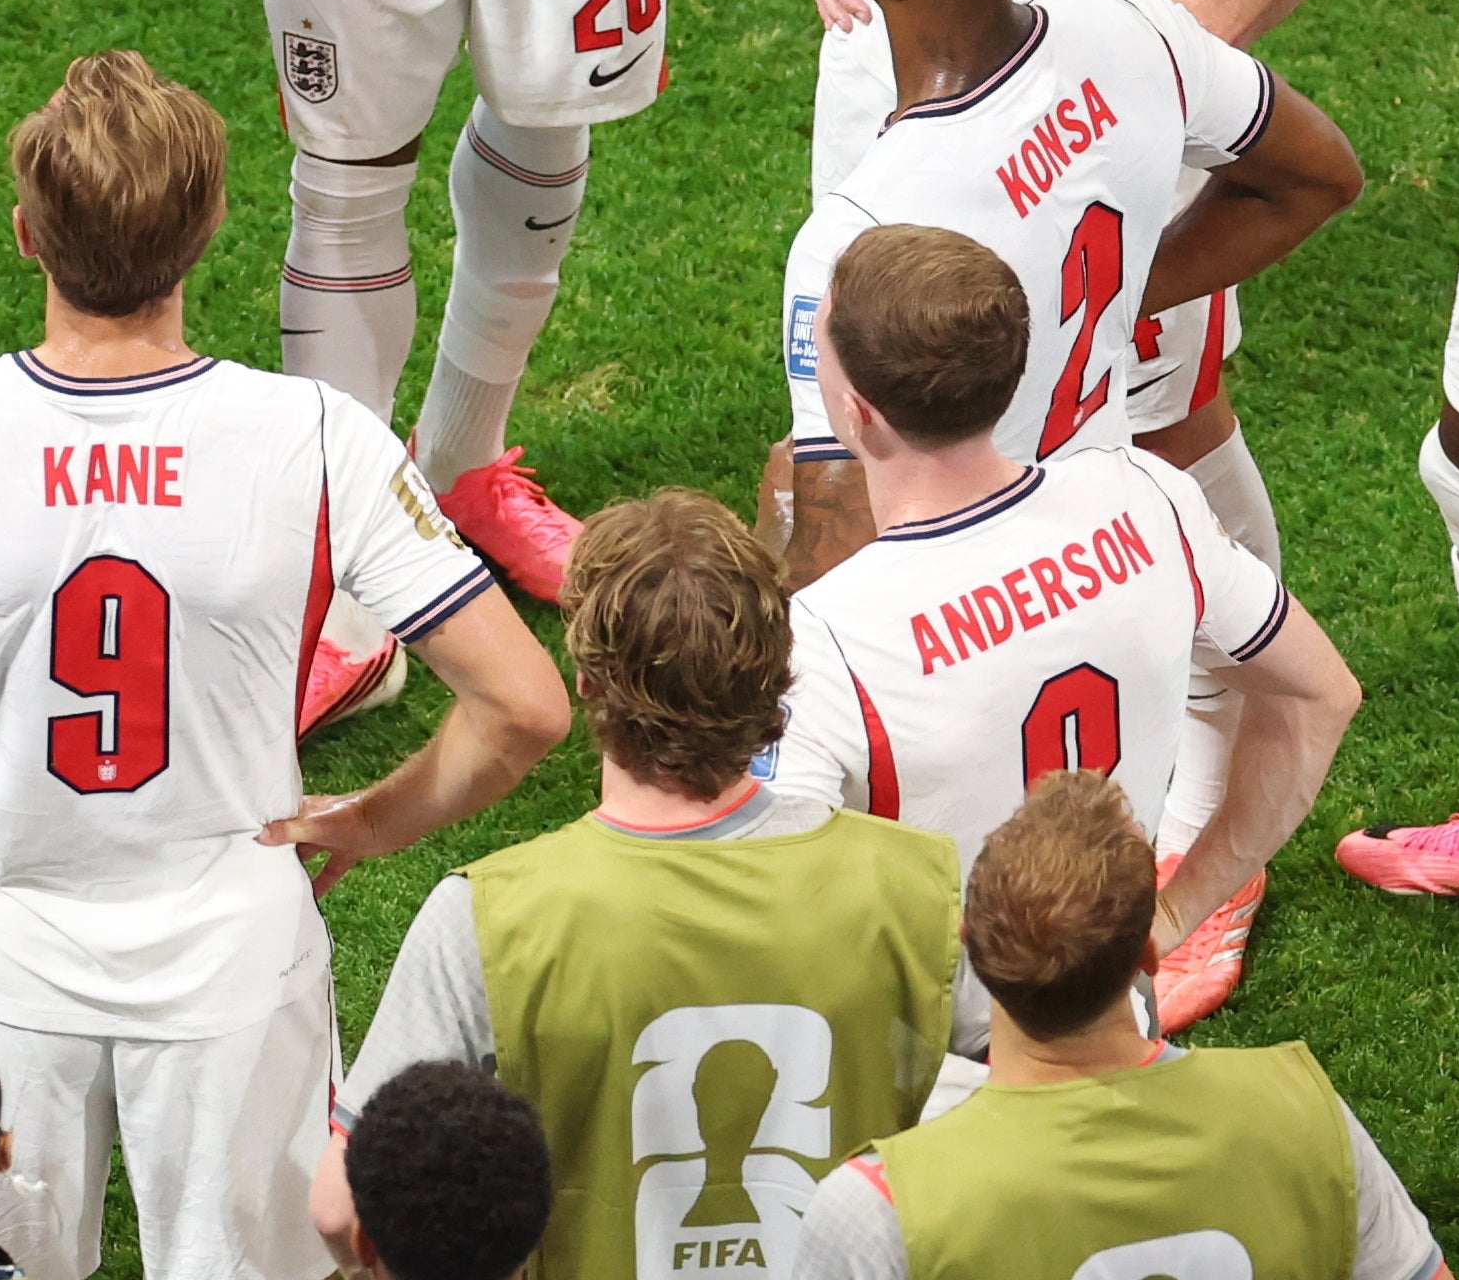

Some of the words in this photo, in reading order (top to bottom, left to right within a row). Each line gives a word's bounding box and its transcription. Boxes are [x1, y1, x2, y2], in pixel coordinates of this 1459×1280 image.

[995, 77, 1120, 220] KONSA
[1037, 199, 1124, 463] 2
[42, 444, 185, 508] KANE
[909, 511, 1155, 677] ANDERSON
[46, 553, 171, 795] 9
[672, 1238, 768, 1271] FIFA
